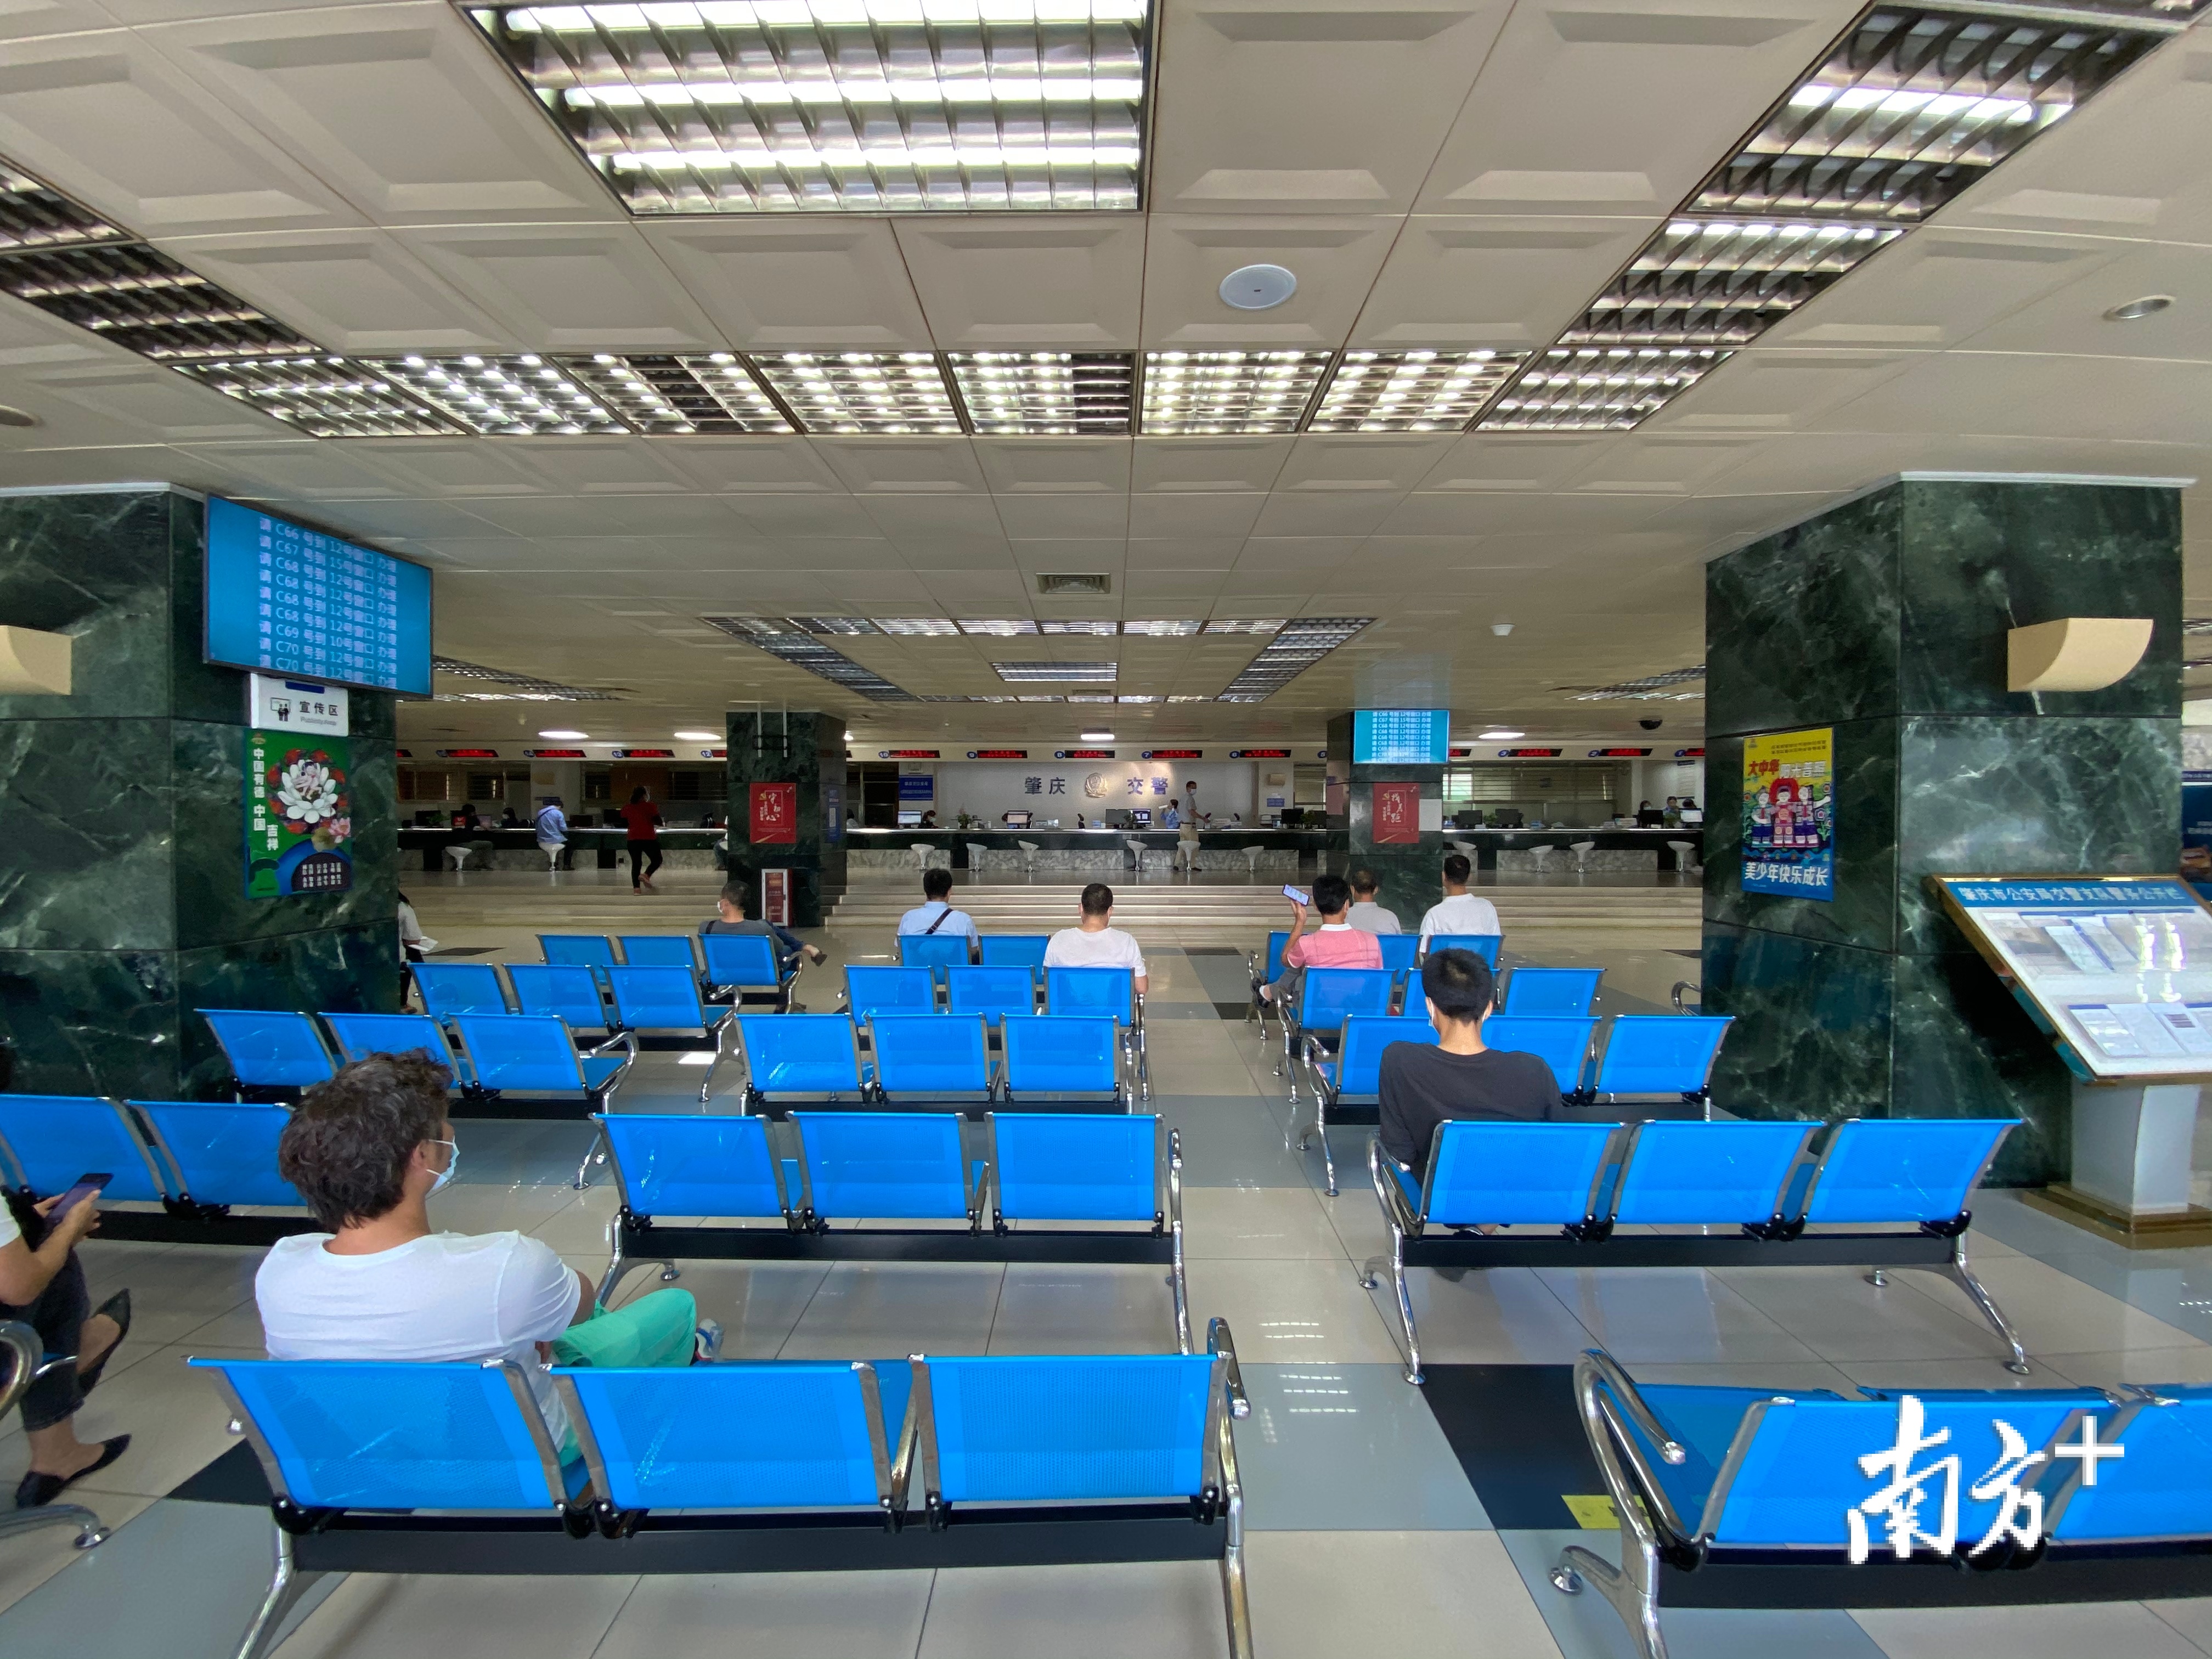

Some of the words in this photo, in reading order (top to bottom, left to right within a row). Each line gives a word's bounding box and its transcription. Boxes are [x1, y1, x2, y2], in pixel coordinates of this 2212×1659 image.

[276, 523, 299, 539] C66
[276, 540, 299, 555] C67
[276, 557, 299, 573] C68
[276, 574, 299, 589] C68
[276, 591, 299, 605] C68
[276, 607, 299, 622] C68
[276, 624, 299, 638] C69
[276, 641, 299, 654] C70
[276, 658, 299, 671] C70
[300, 701, 338, 716] 宣传区
[1748, 759, 1780, 776] 大中华
[1024, 776, 1065, 795] 肇庆
[1127, 777, 1169, 795] 交警
[1744, 862, 1829, 886] 美少年快乐成长
